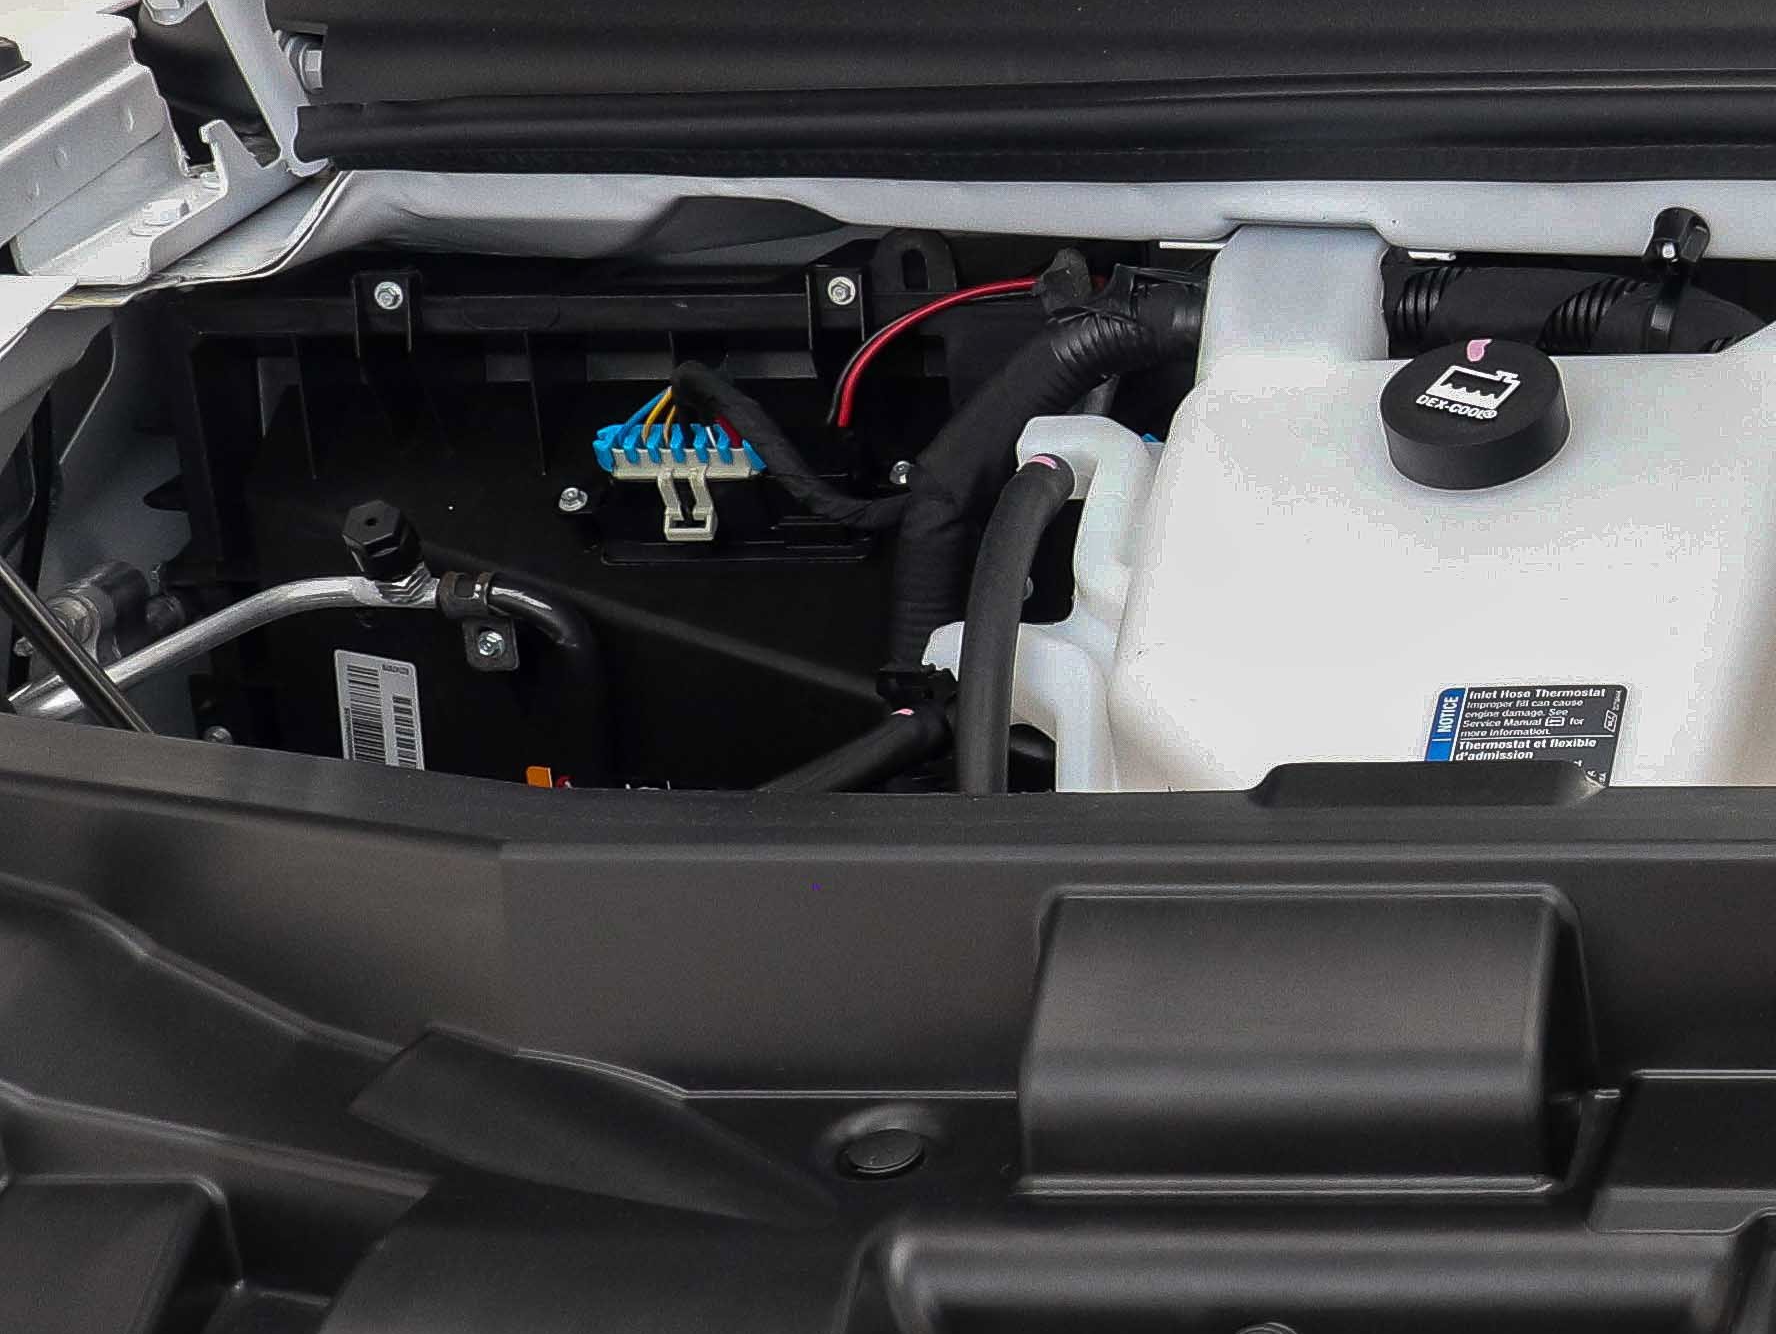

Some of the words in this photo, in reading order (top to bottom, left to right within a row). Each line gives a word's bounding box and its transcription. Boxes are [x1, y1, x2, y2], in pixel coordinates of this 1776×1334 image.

[1469, 690, 1497, 700] Inlet
[1501, 689, 1531, 700] Hose
[1535, 688, 1606, 699] Thermostat
[1466, 700, 1513, 710] Improper
[1531, 700, 1551, 708] can
[1552, 699, 1584, 708] cause
[1437, 695, 1460, 734] NOTICE
[1464, 710, 1499, 720] engine
[1501, 708, 1547, 719] damage.
[1548, 708, 1569, 717] See
[1462, 719, 1501, 728] Service
[1504, 718, 1542, 727] Manual
[1568, 717, 1585, 727] for
[1460, 728, 1487, 738] more
[1489, 727, 1551, 737] information.
[1458, 739, 1531, 750] Thermostat
[1532, 740, 1547, 749] et
[1549, 738, 1597, 749] flexible
[1455, 750, 1534, 761] d'admission
